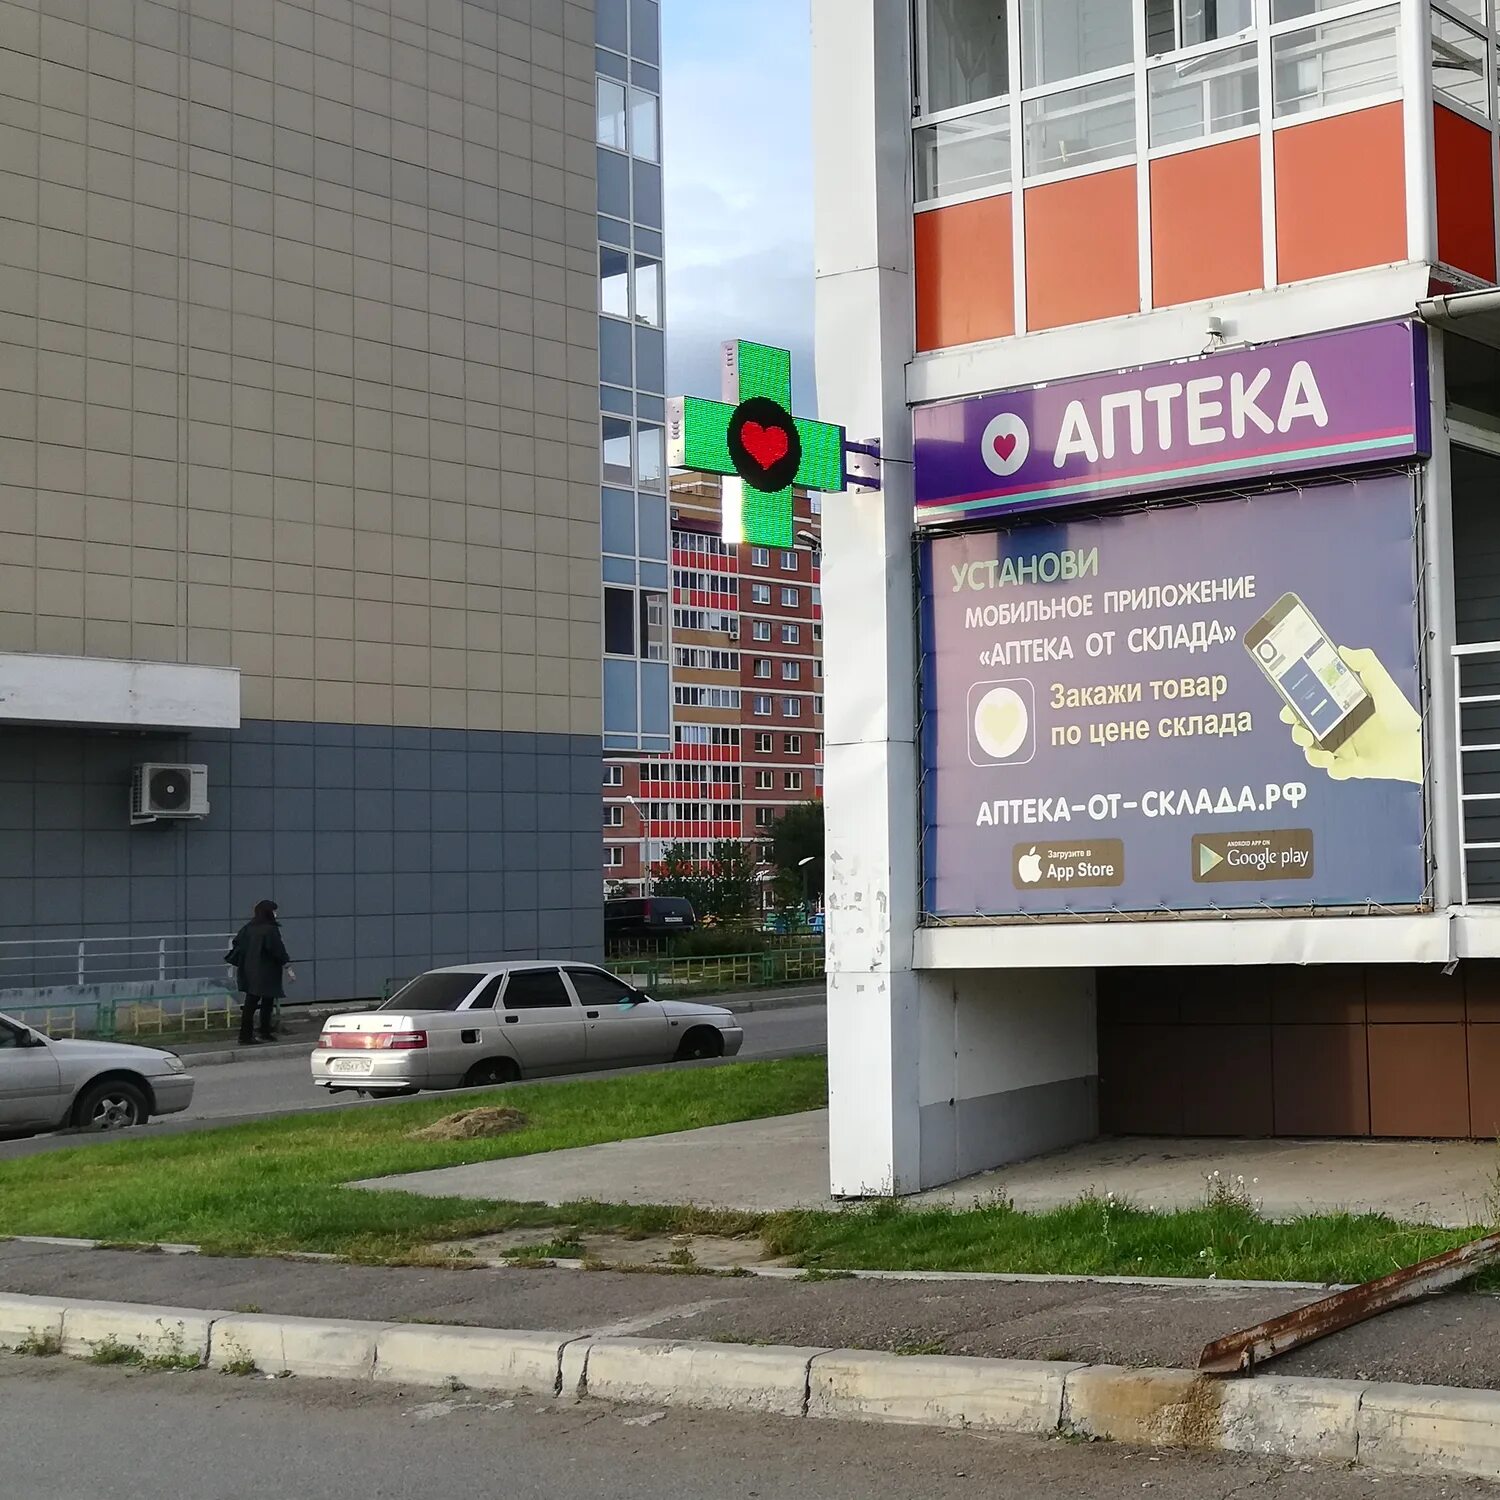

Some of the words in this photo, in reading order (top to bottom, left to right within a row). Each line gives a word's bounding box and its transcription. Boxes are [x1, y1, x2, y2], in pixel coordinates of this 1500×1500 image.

[1053, 360, 1329, 468] АПТЕКА
[951, 547, 1098, 592] УСТАНОВИ
[965, 594, 1093, 628] МОБИЛЬНОЕ
[1103, 575, 1256, 613] ПРИЛОЖЕНИЕ
[979, 635, 1074, 667] «АПТЕКА
[1085, 631, 1116, 657] ОТ
[1127, 619, 1237, 653] СКЛАДА»
[1050, 683, 1142, 709] Закажи
[1149, 674, 1228, 702] товар
[1051, 725, 1082, 746] по
[1089, 719, 1150, 746] цене
[1158, 711, 1253, 738] склада
[1046, 863, 1074, 882] App
[1078, 862, 1114, 876] Store
[1047, 850, 1085, 860] Загрузите
[1227, 848, 1277, 871] Google
[1281, 847, 1309, 868] play
